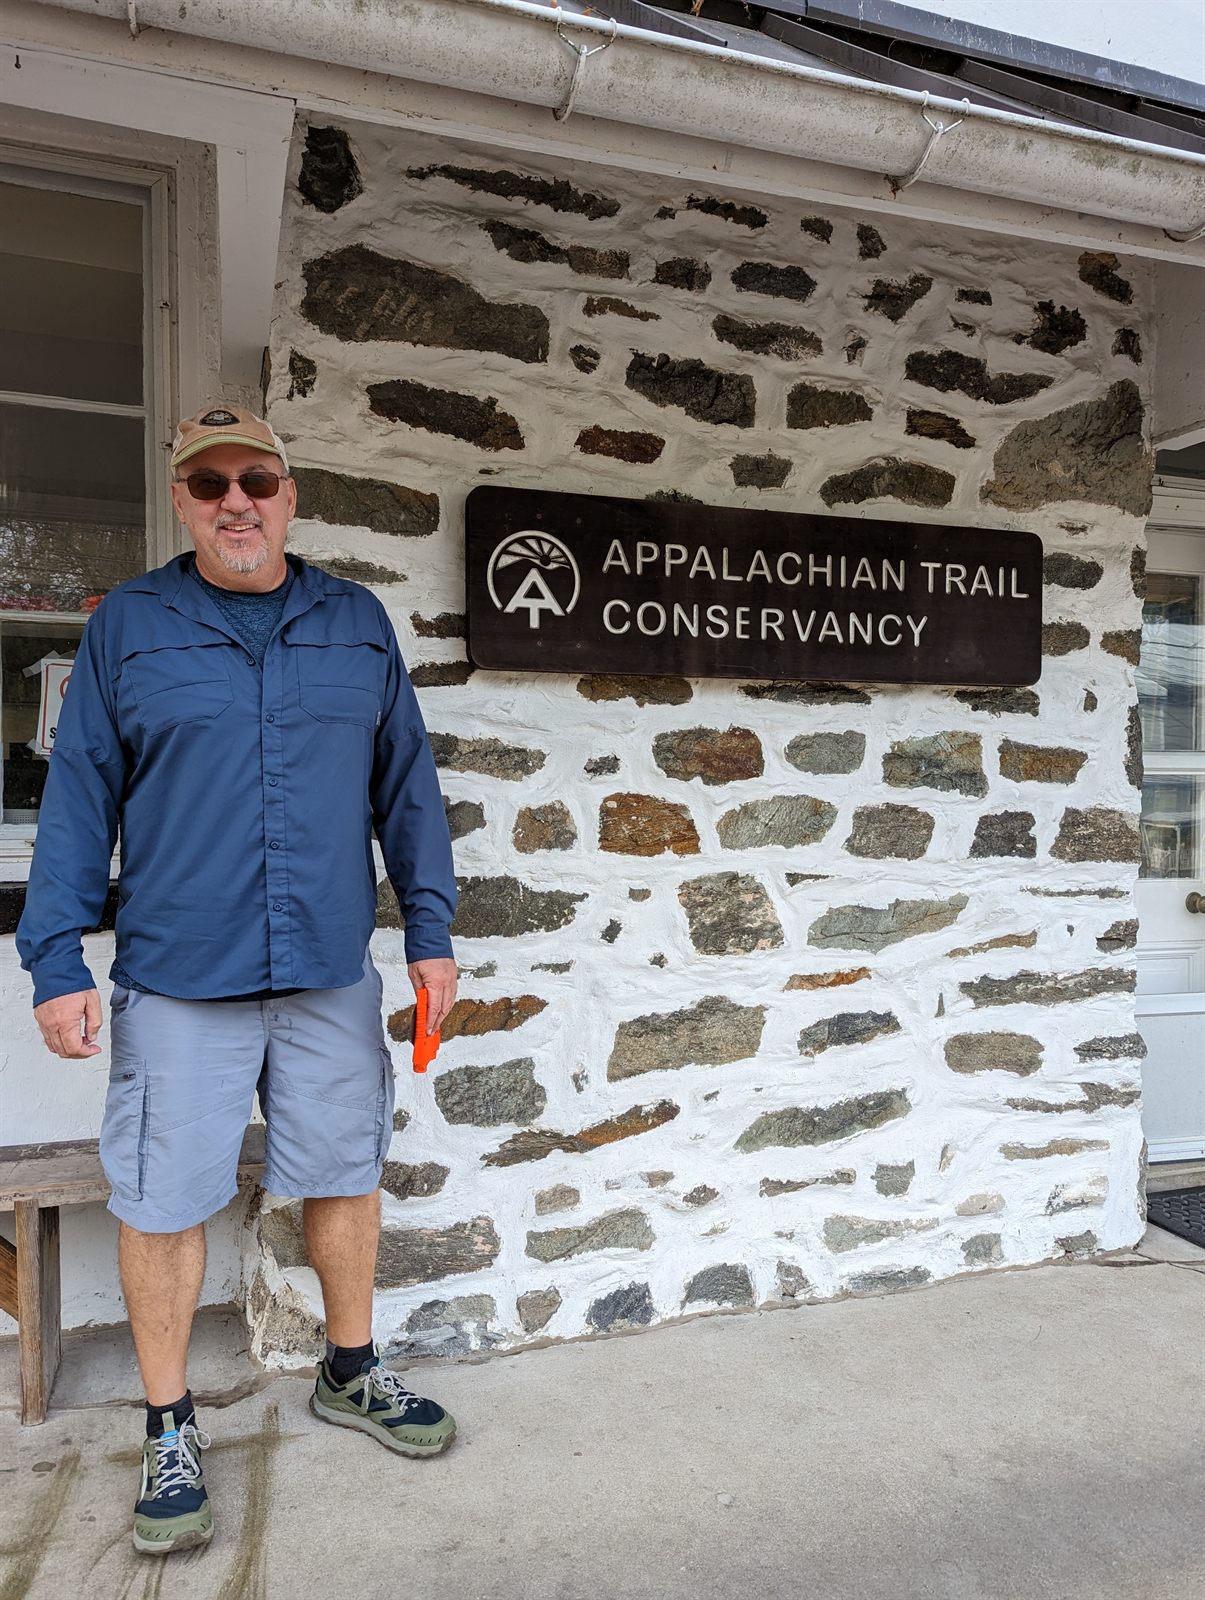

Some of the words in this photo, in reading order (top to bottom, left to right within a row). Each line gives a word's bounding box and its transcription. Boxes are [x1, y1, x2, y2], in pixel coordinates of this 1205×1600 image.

[602, 538, 905, 592] APPALACHIAN
[919, 561, 1030, 599] TRAIL
[602, 599, 928, 648] CONSERVANCY
